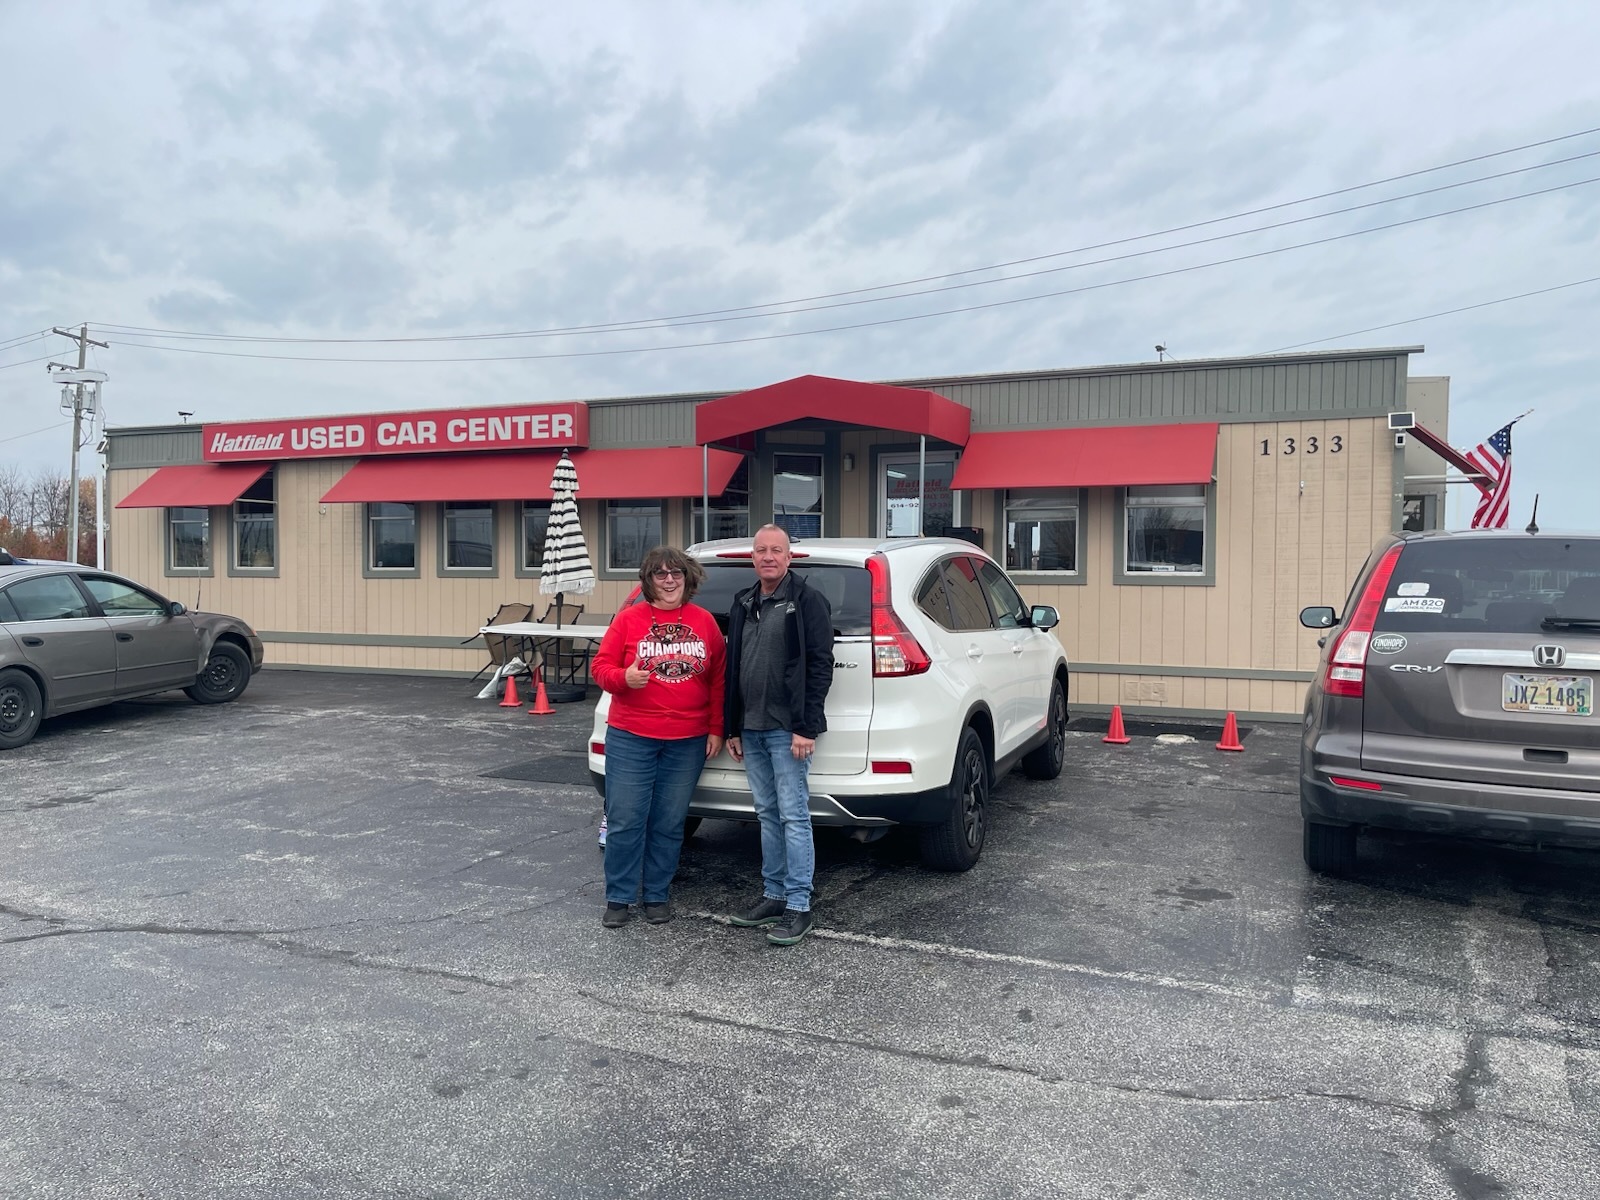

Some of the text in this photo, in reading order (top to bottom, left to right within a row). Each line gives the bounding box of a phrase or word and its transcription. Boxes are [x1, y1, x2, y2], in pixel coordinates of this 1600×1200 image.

[210, 413, 573, 453] Hatfield USED CAR CENTER
[1260, 435, 1344, 456] 1333
[896, 480, 942, 488] Hateld
[639, 641, 706, 658] CHAMPIONS
[1389, 664, 1443, 674] CR-V
[1510, 685, 1586, 708] JXZ 1485
